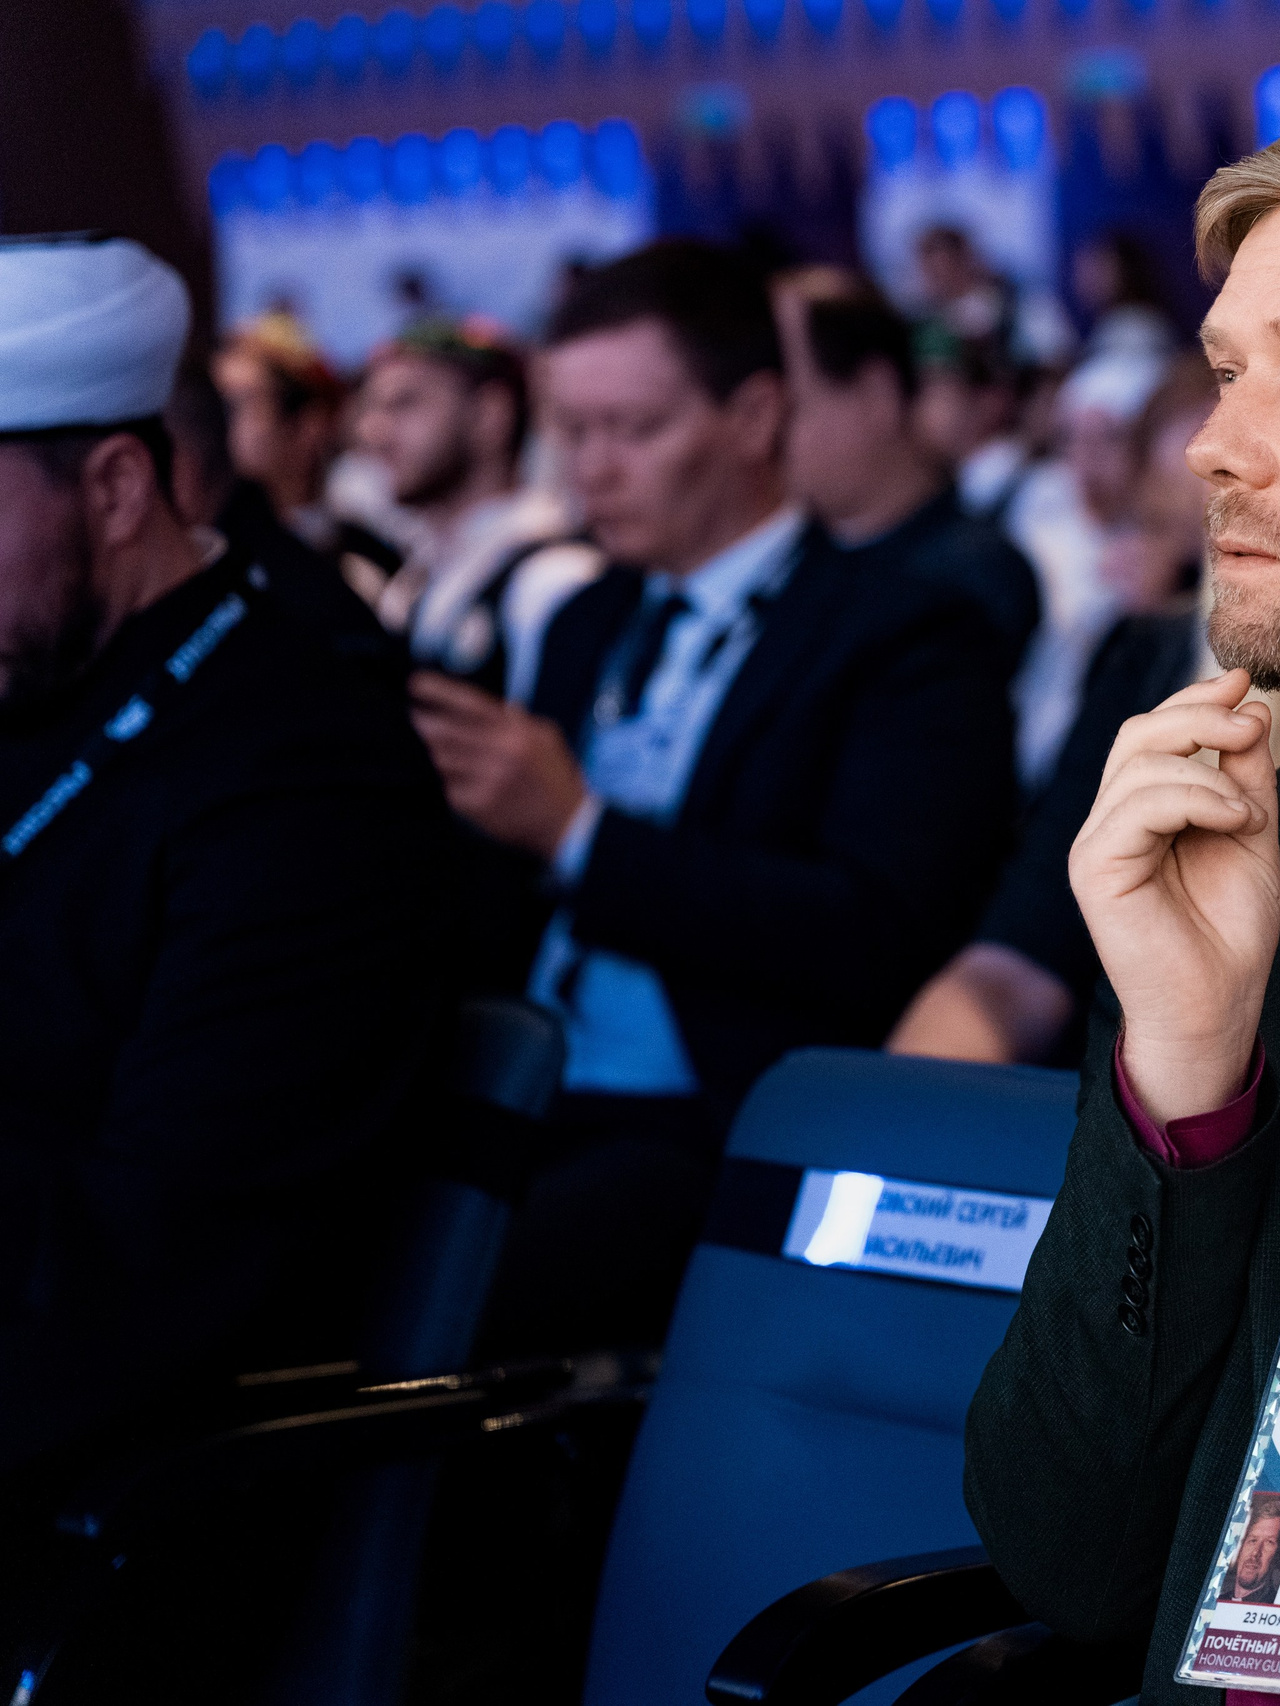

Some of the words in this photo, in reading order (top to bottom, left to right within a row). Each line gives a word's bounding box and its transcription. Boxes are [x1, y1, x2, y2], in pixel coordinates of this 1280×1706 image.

[1243, 1612, 1257, 1624] 23
[1204, 1634, 1278, 1656] ПОЧЁТНЫЙ
[1199, 1653, 1262, 1670] HONORARY
